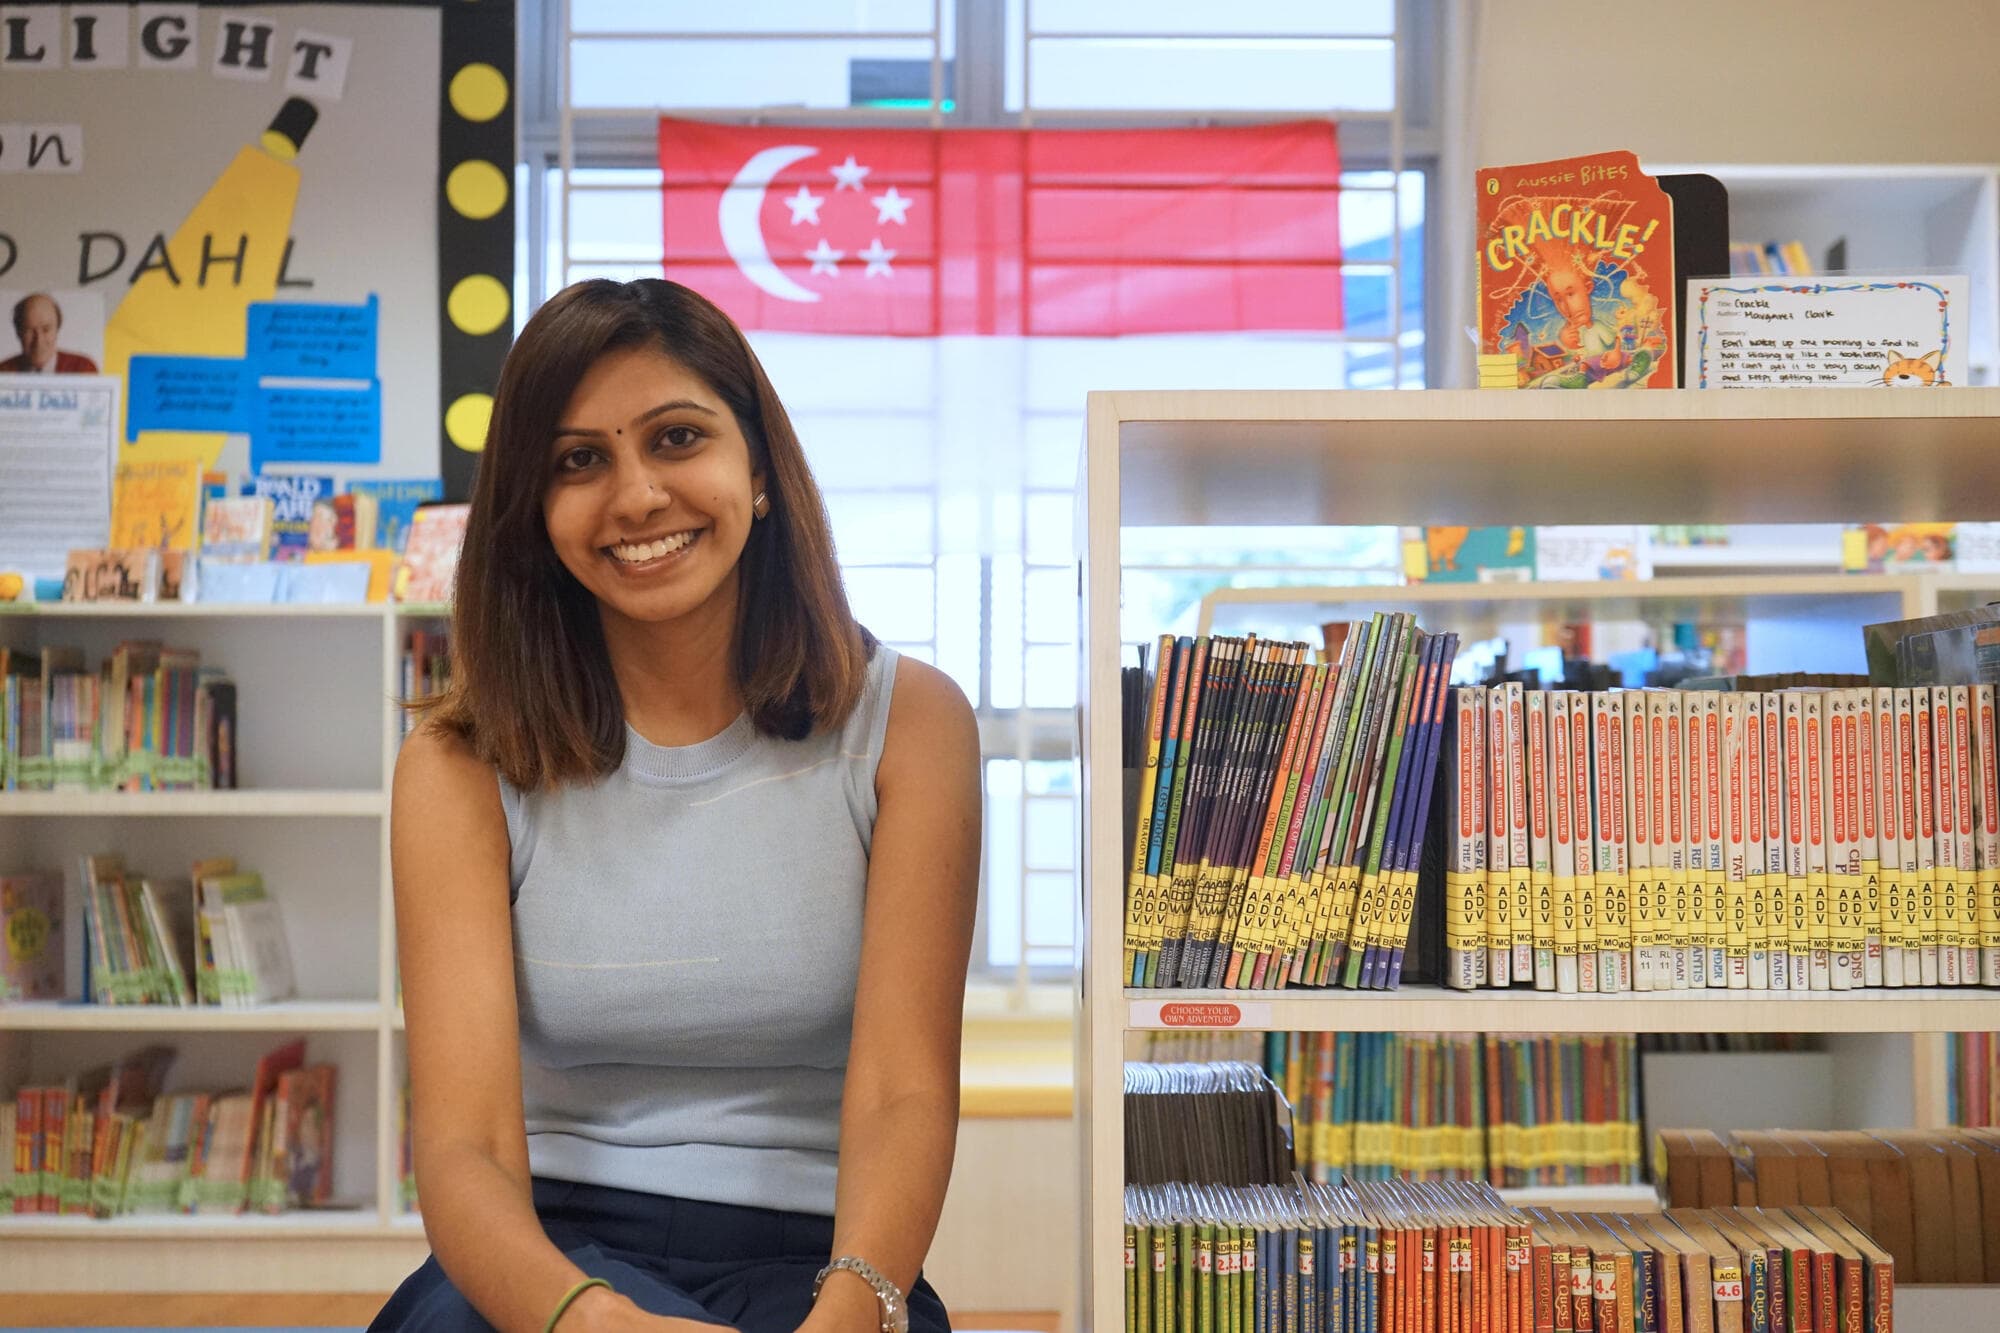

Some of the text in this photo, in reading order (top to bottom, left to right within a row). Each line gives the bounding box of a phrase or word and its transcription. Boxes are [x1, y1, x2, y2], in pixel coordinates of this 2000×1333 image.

[5, 15, 331, 80] LIGHT
[1486, 203, 1659, 271] CRACKLE!
[78, 232, 314, 287] DAHL
[1735, 299, 1770, 308] Crackle
[1805, 310, 1834, 319] Clark
[1823, 339, 1862, 349] morning
[1789, 729, 1797, 757] CHOOSE
[1576, 725, 1586, 832] CHOOSE YOUR OWN ADVENTURE
[1790, 760, 1798, 778] YOUR
[1884, 776, 1892, 791] OWN
[1922, 774, 1930, 789] OWN
[1157, 786, 1170, 815] LOST
[1751, 797, 1759, 835] ADVENTURE
[1770, 794, 1778, 832] ADVENTURE
[1885, 794, 1893, 832] ADVENTURE
[1923, 792, 1931, 830] ADVENTURE
[1791, 798, 1800, 836] ADVENTURE
[1139, 818, 1150, 856] DRAGON
[1259, 812, 1276, 860] OWL TREE
[1165, 1015, 1234, 1024] OWN ADVENTURE
[1171, 1006, 1230, 1015] CHOOSE YOUR
[1643, 1255, 1653, 1286] Beast
[1754, 1255, 1764, 1286] Beast
[1822, 1263, 1831, 1294] Beast
[1879, 1269, 1890, 1300] Beast
[1717, 1285, 1740, 1297] 4.6
